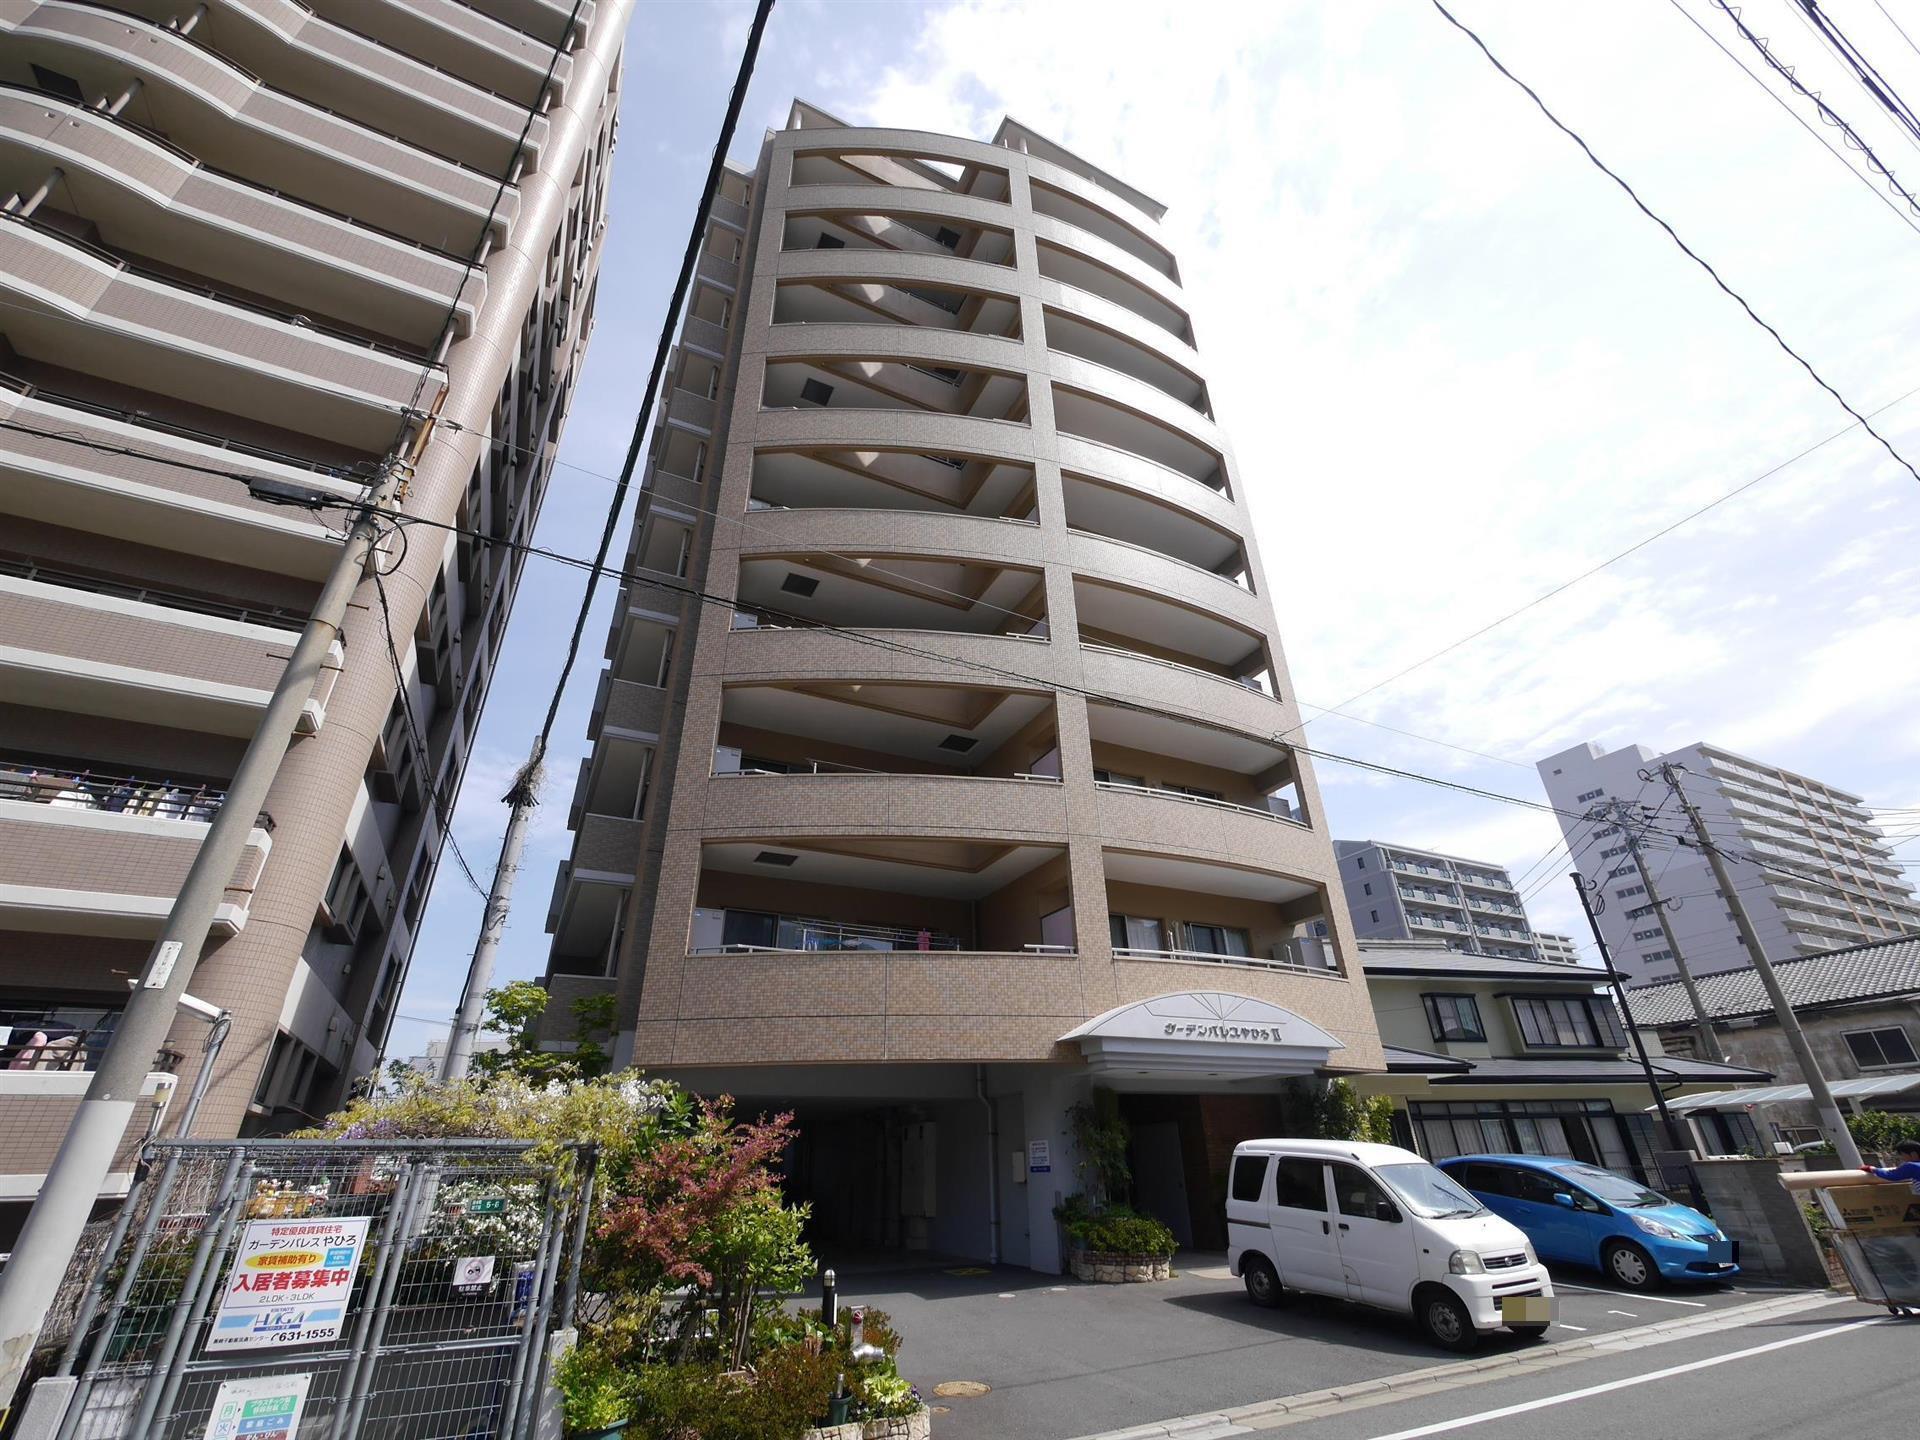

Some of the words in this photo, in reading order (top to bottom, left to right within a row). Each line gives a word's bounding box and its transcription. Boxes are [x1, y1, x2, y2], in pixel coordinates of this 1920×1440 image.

[271, 1225, 342, 1236] 特定優良賃貸住宅
[257, 1253, 317, 1266] 家賃補助有り
[232, 1268, 350, 1293] 入居者募集中
[279, 1328, 335, 1342] 631-1555
